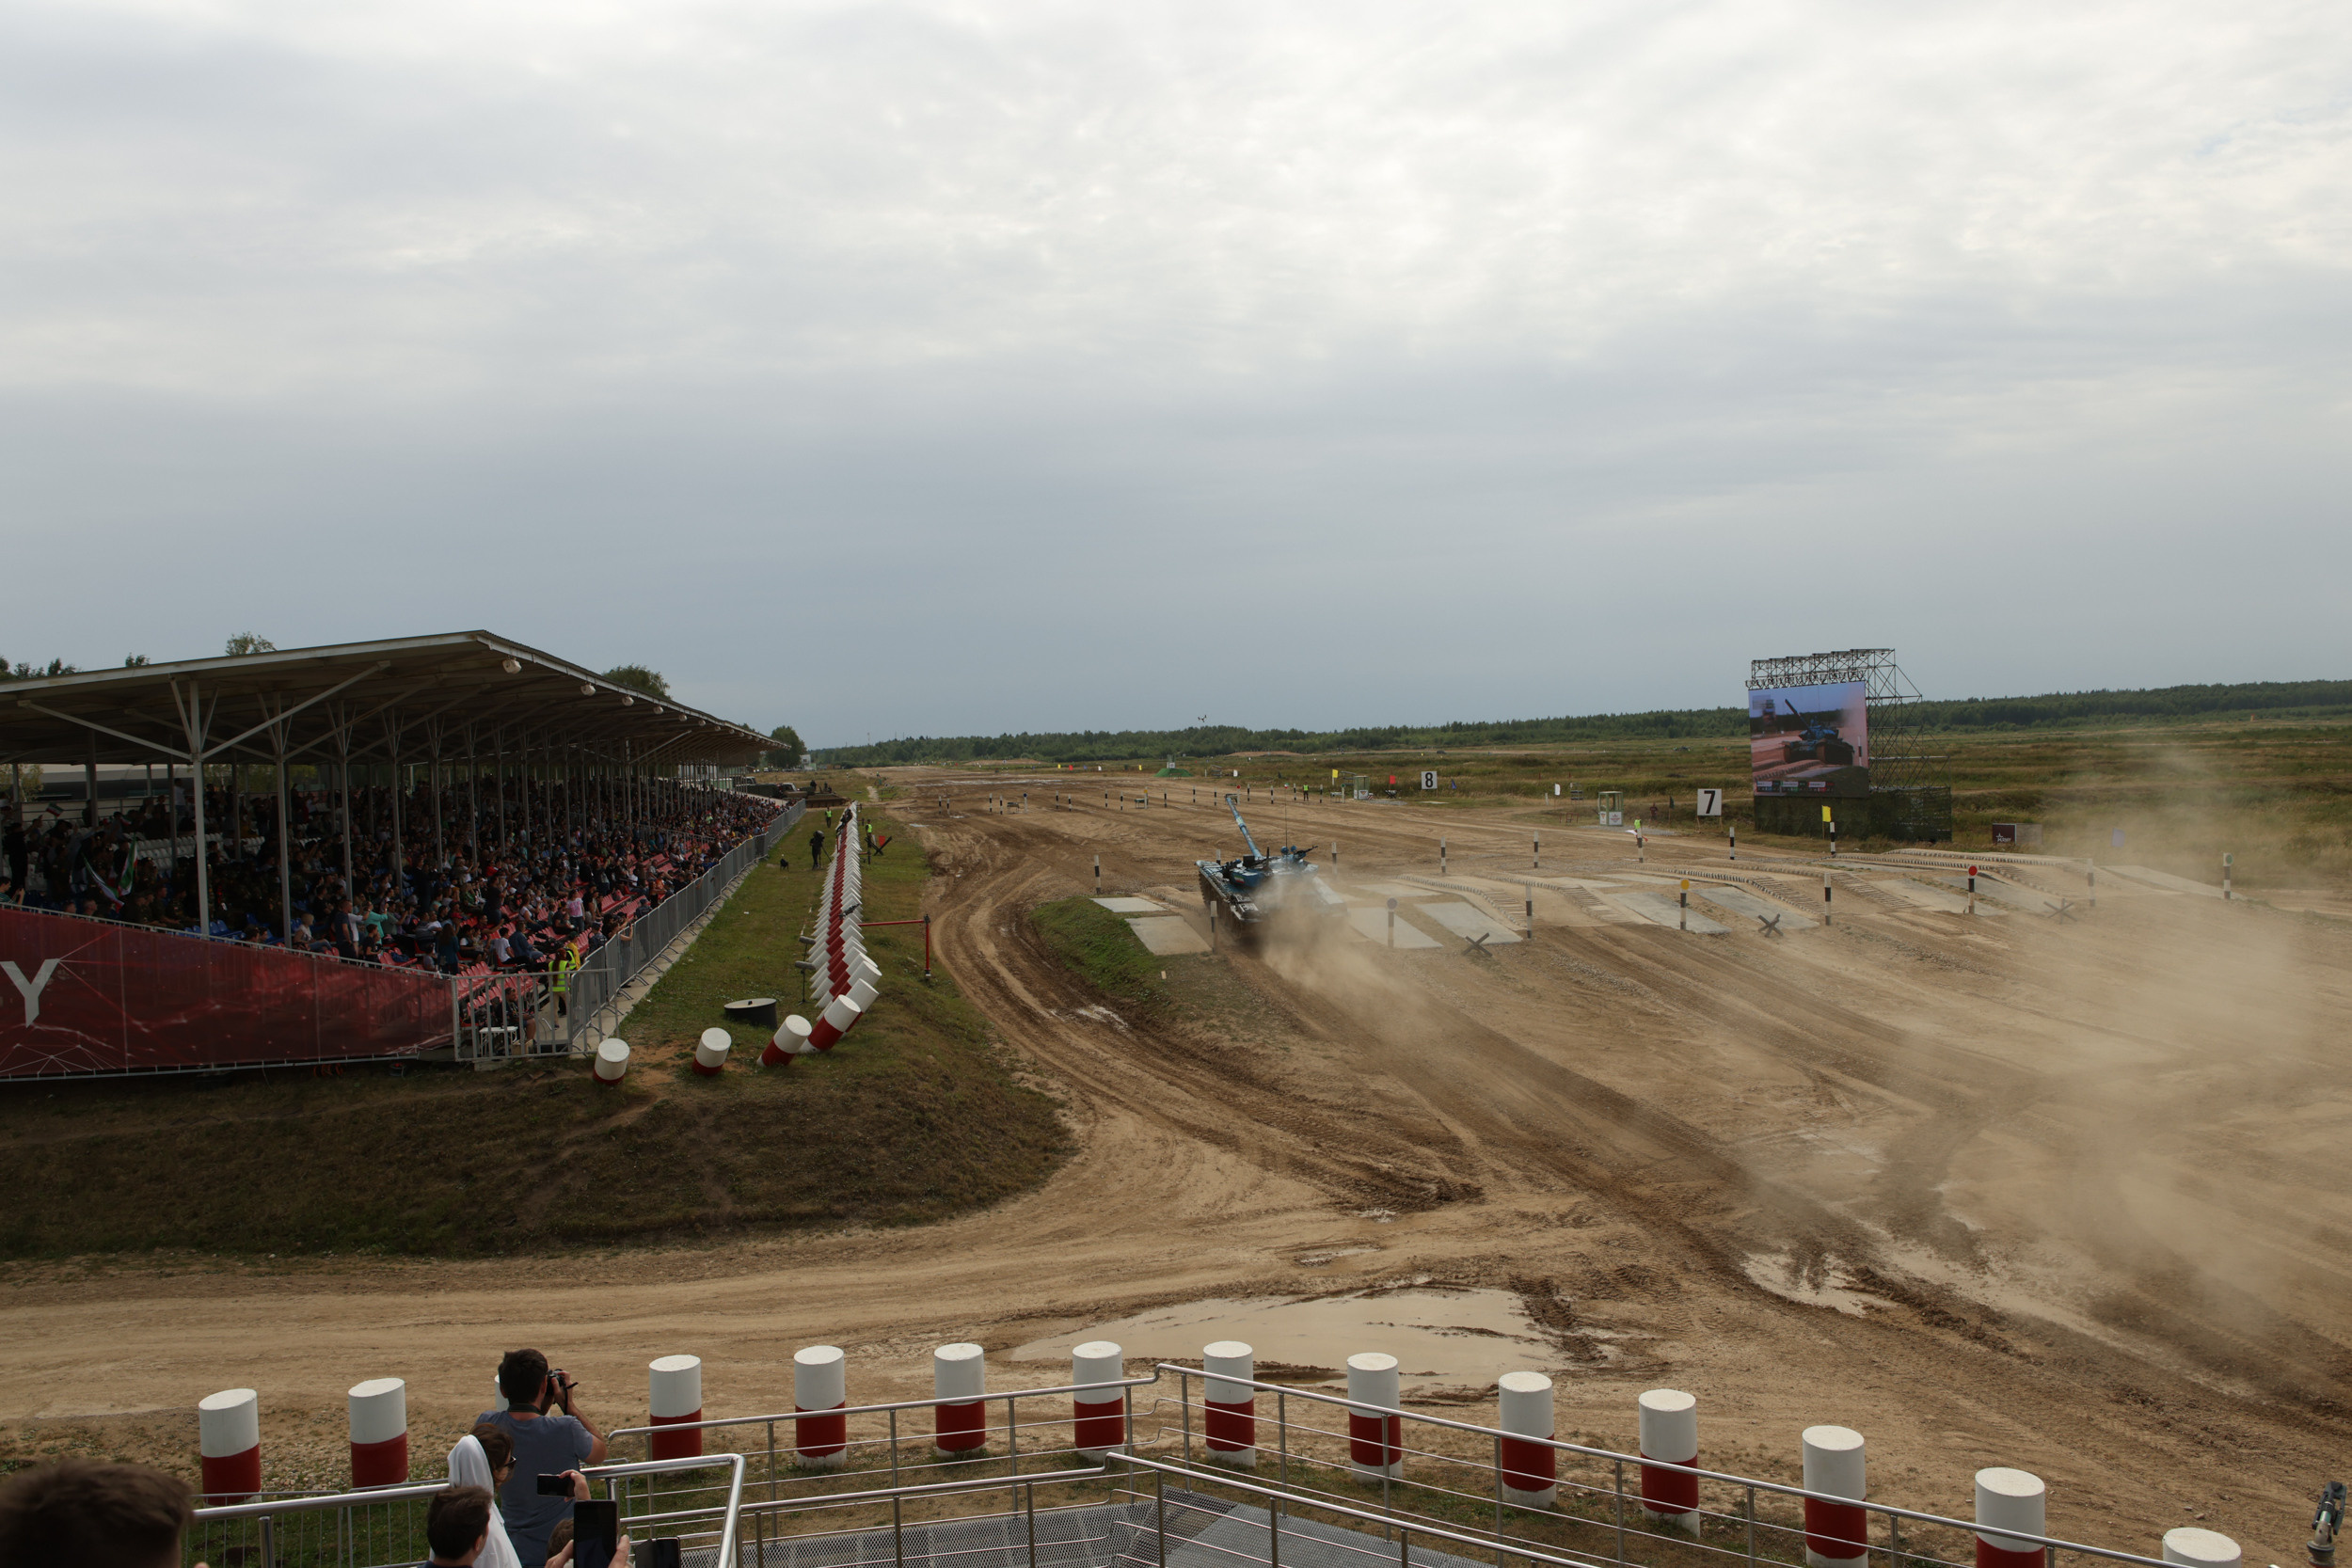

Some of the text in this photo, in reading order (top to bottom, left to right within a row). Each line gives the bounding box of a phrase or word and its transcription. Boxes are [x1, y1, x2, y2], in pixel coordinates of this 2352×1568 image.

[1425, 772, 1434, 787] 8
[1704, 790, 1716, 814] 7
[0, 958, 60, 1028] Y
